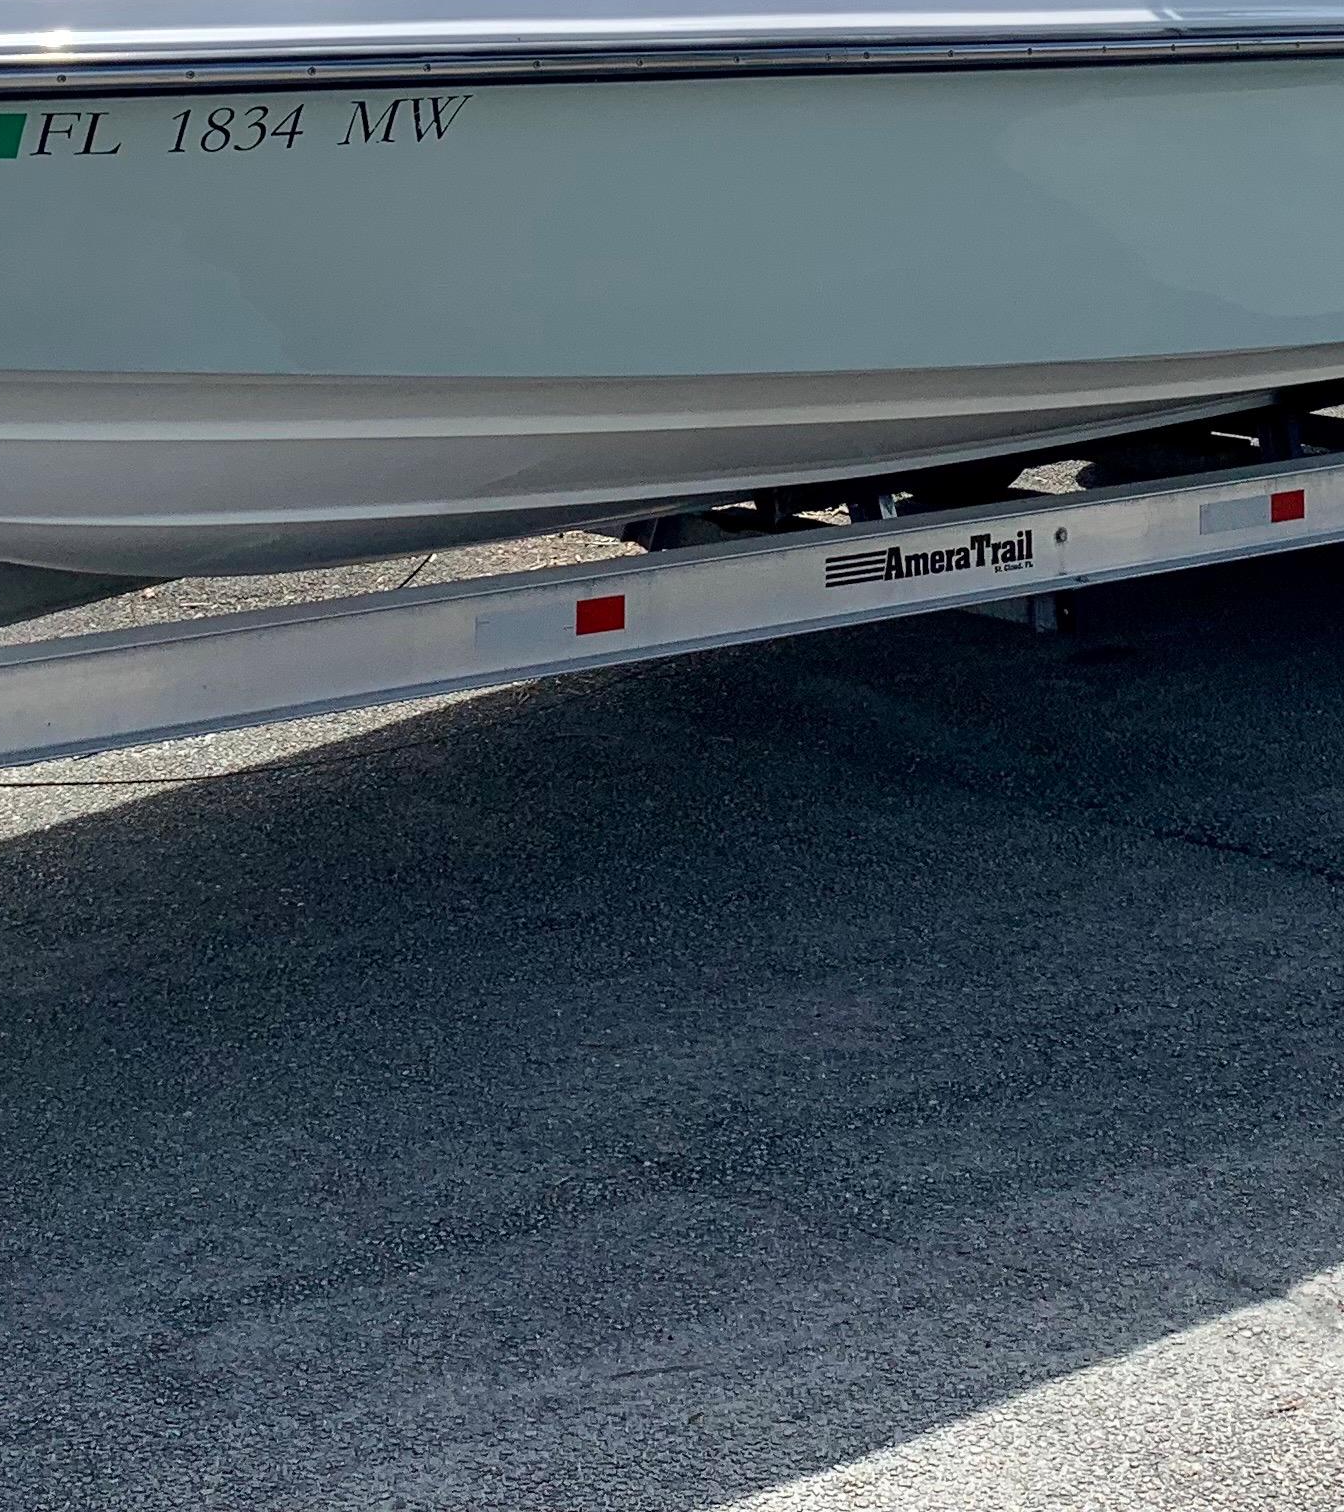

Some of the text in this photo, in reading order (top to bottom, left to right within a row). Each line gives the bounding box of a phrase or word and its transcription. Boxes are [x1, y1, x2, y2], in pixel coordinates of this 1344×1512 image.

[29, 94, 474, 156] FL 1834 MW
[884, 530, 1033, 581] AmeraTrail
